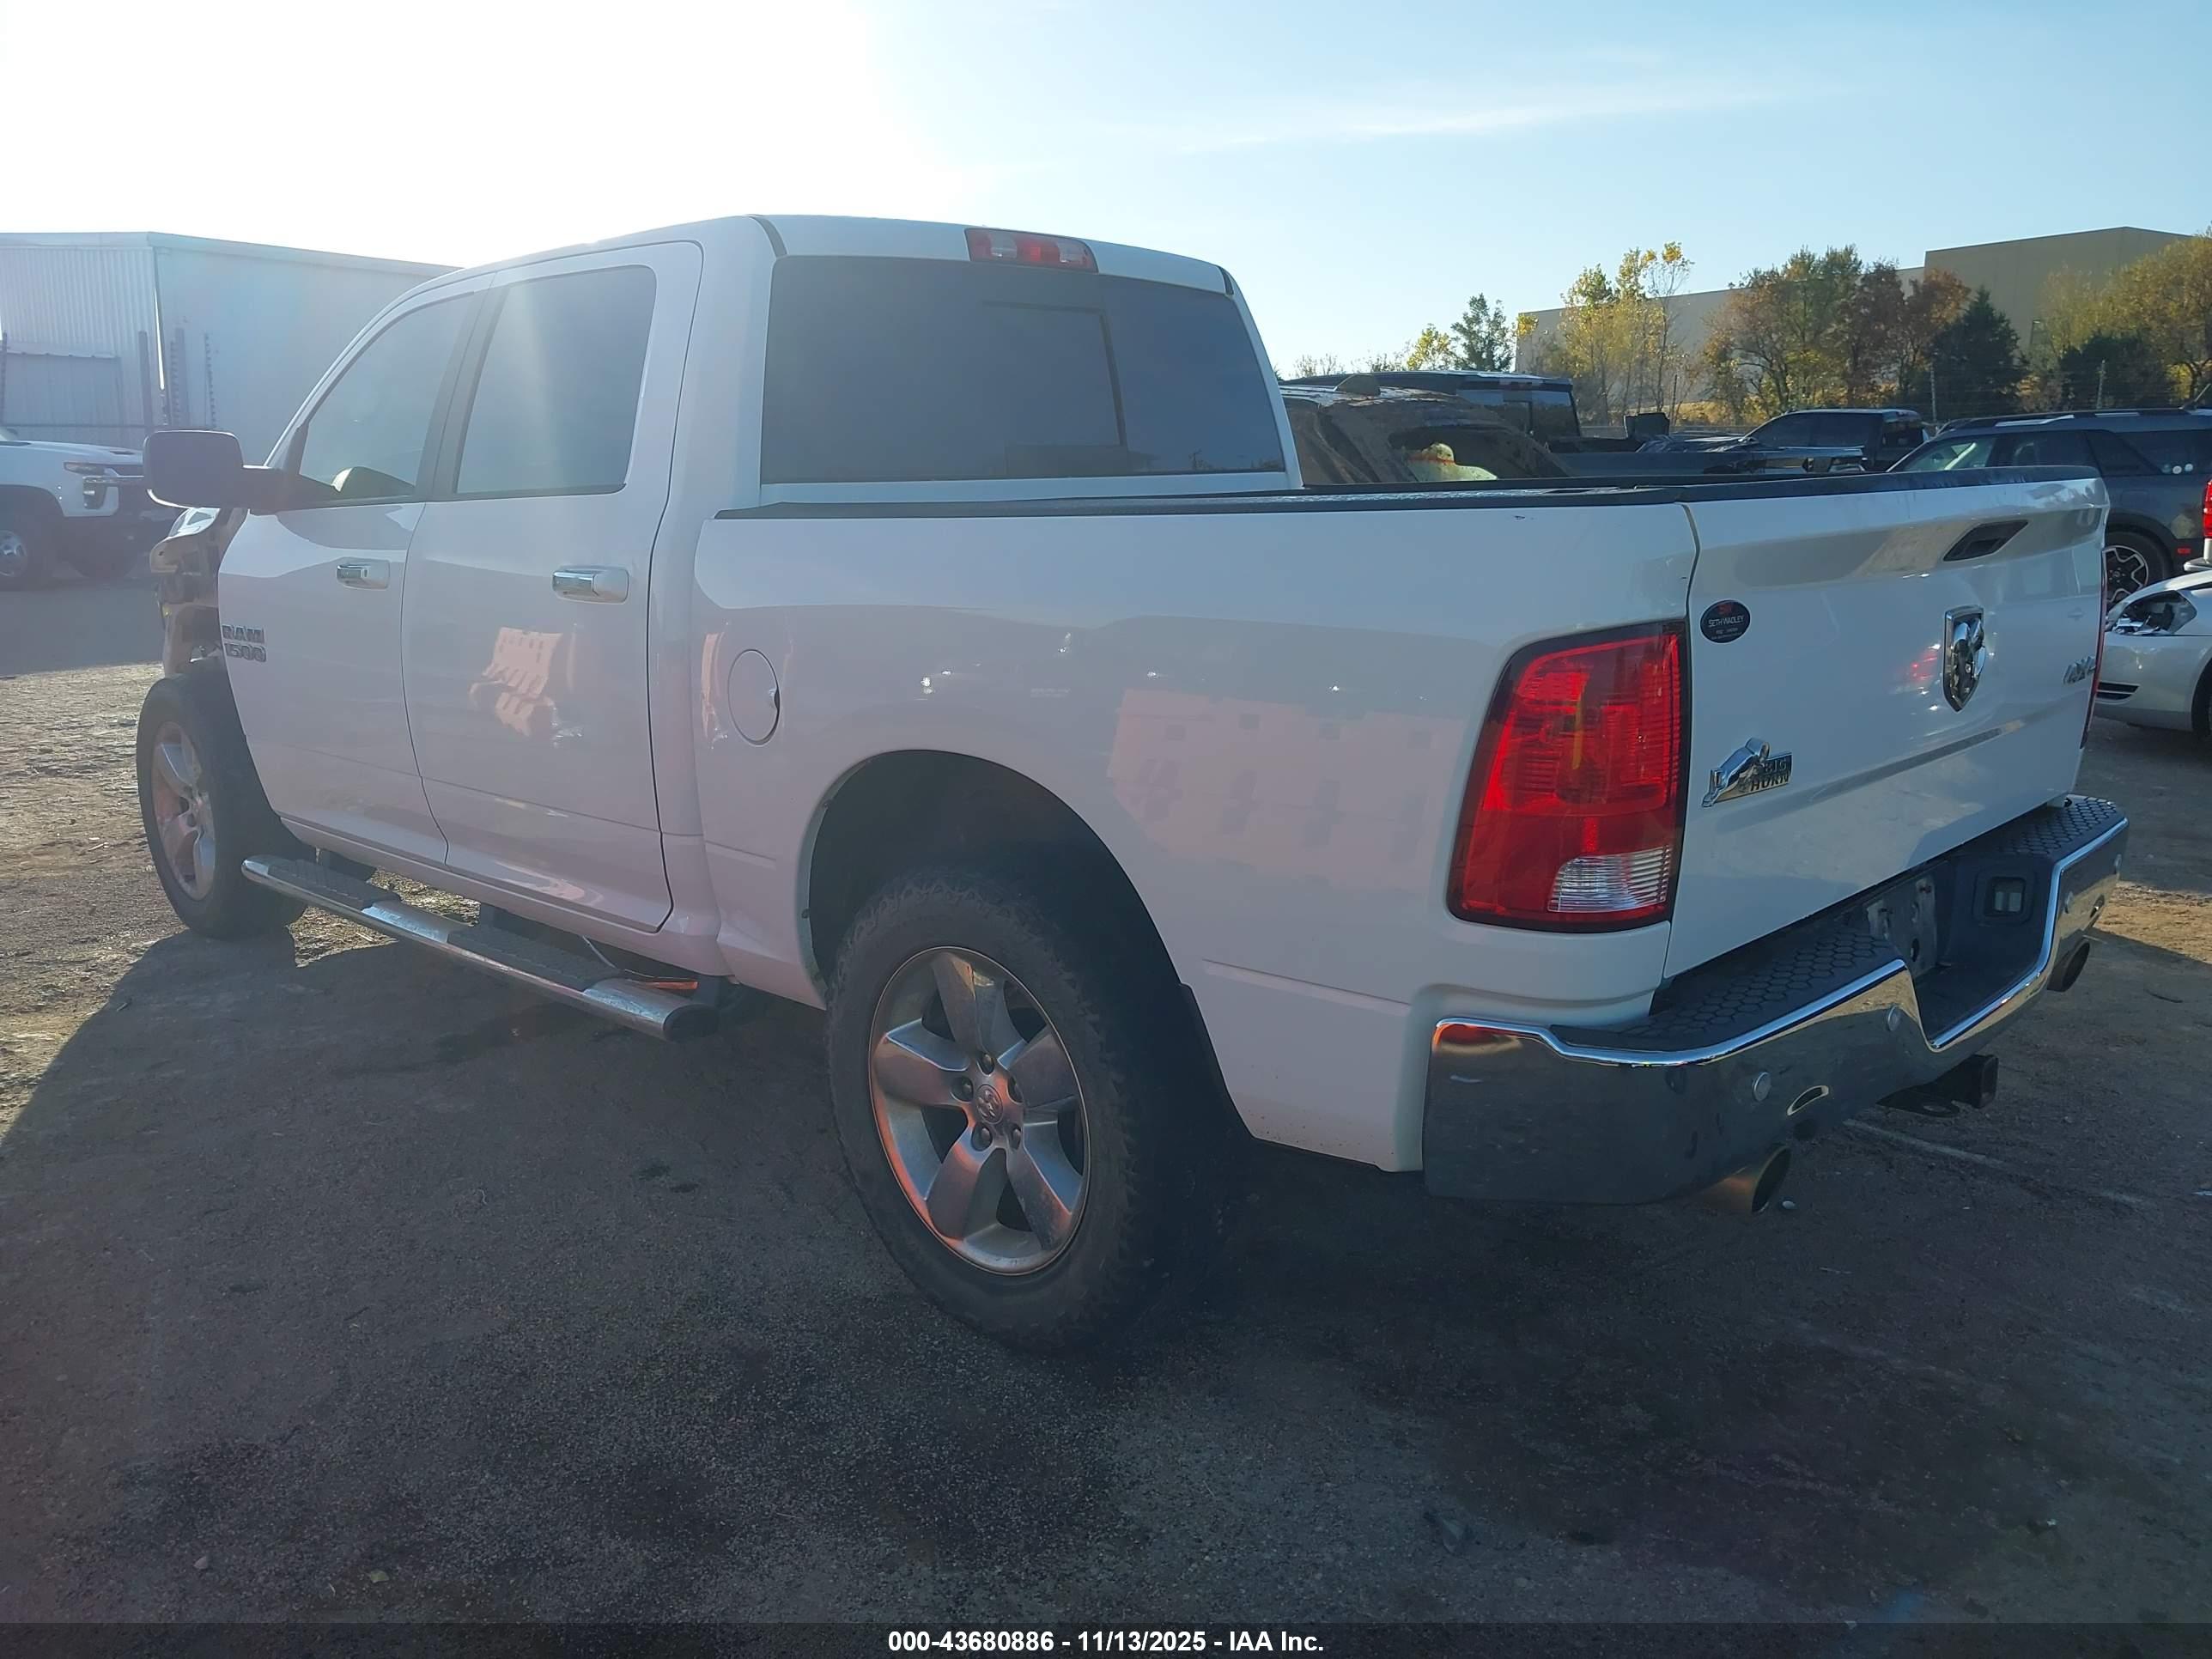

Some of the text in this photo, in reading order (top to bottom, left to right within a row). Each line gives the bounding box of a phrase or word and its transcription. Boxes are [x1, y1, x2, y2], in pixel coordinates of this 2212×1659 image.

[222, 624, 264, 644] RAM
[223, 642, 266, 662] 1500
[1750, 769, 1790, 792] HORN
